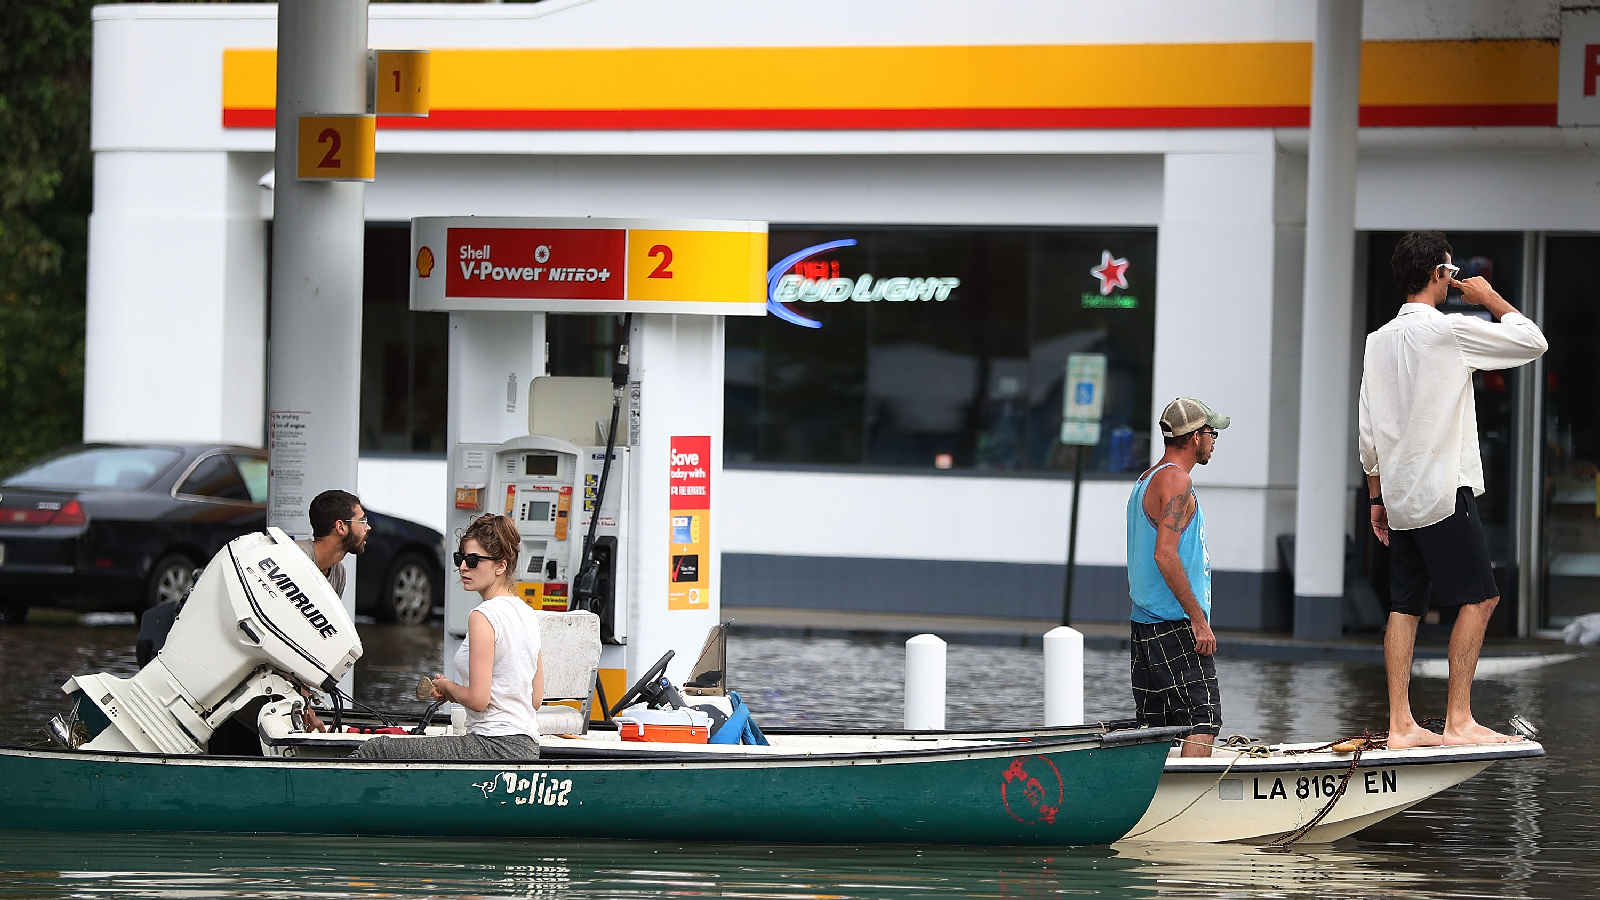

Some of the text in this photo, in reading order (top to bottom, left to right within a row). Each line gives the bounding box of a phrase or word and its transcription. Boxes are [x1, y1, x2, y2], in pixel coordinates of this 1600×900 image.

[392, 70, 401, 92] 1
[317, 128, 342, 168] 2
[459, 245, 491, 260] Shell
[647, 244, 673, 279] 2
[460, 261, 542, 281] V-Power
[671, 448, 700, 466] Save
[688, 467, 707, 478] with
[246, 566, 278, 599] E-TEC
[258, 557, 338, 641] EVINRUDE
[1253, 777, 1287, 800] LA
[1364, 769, 1397, 794] EN
